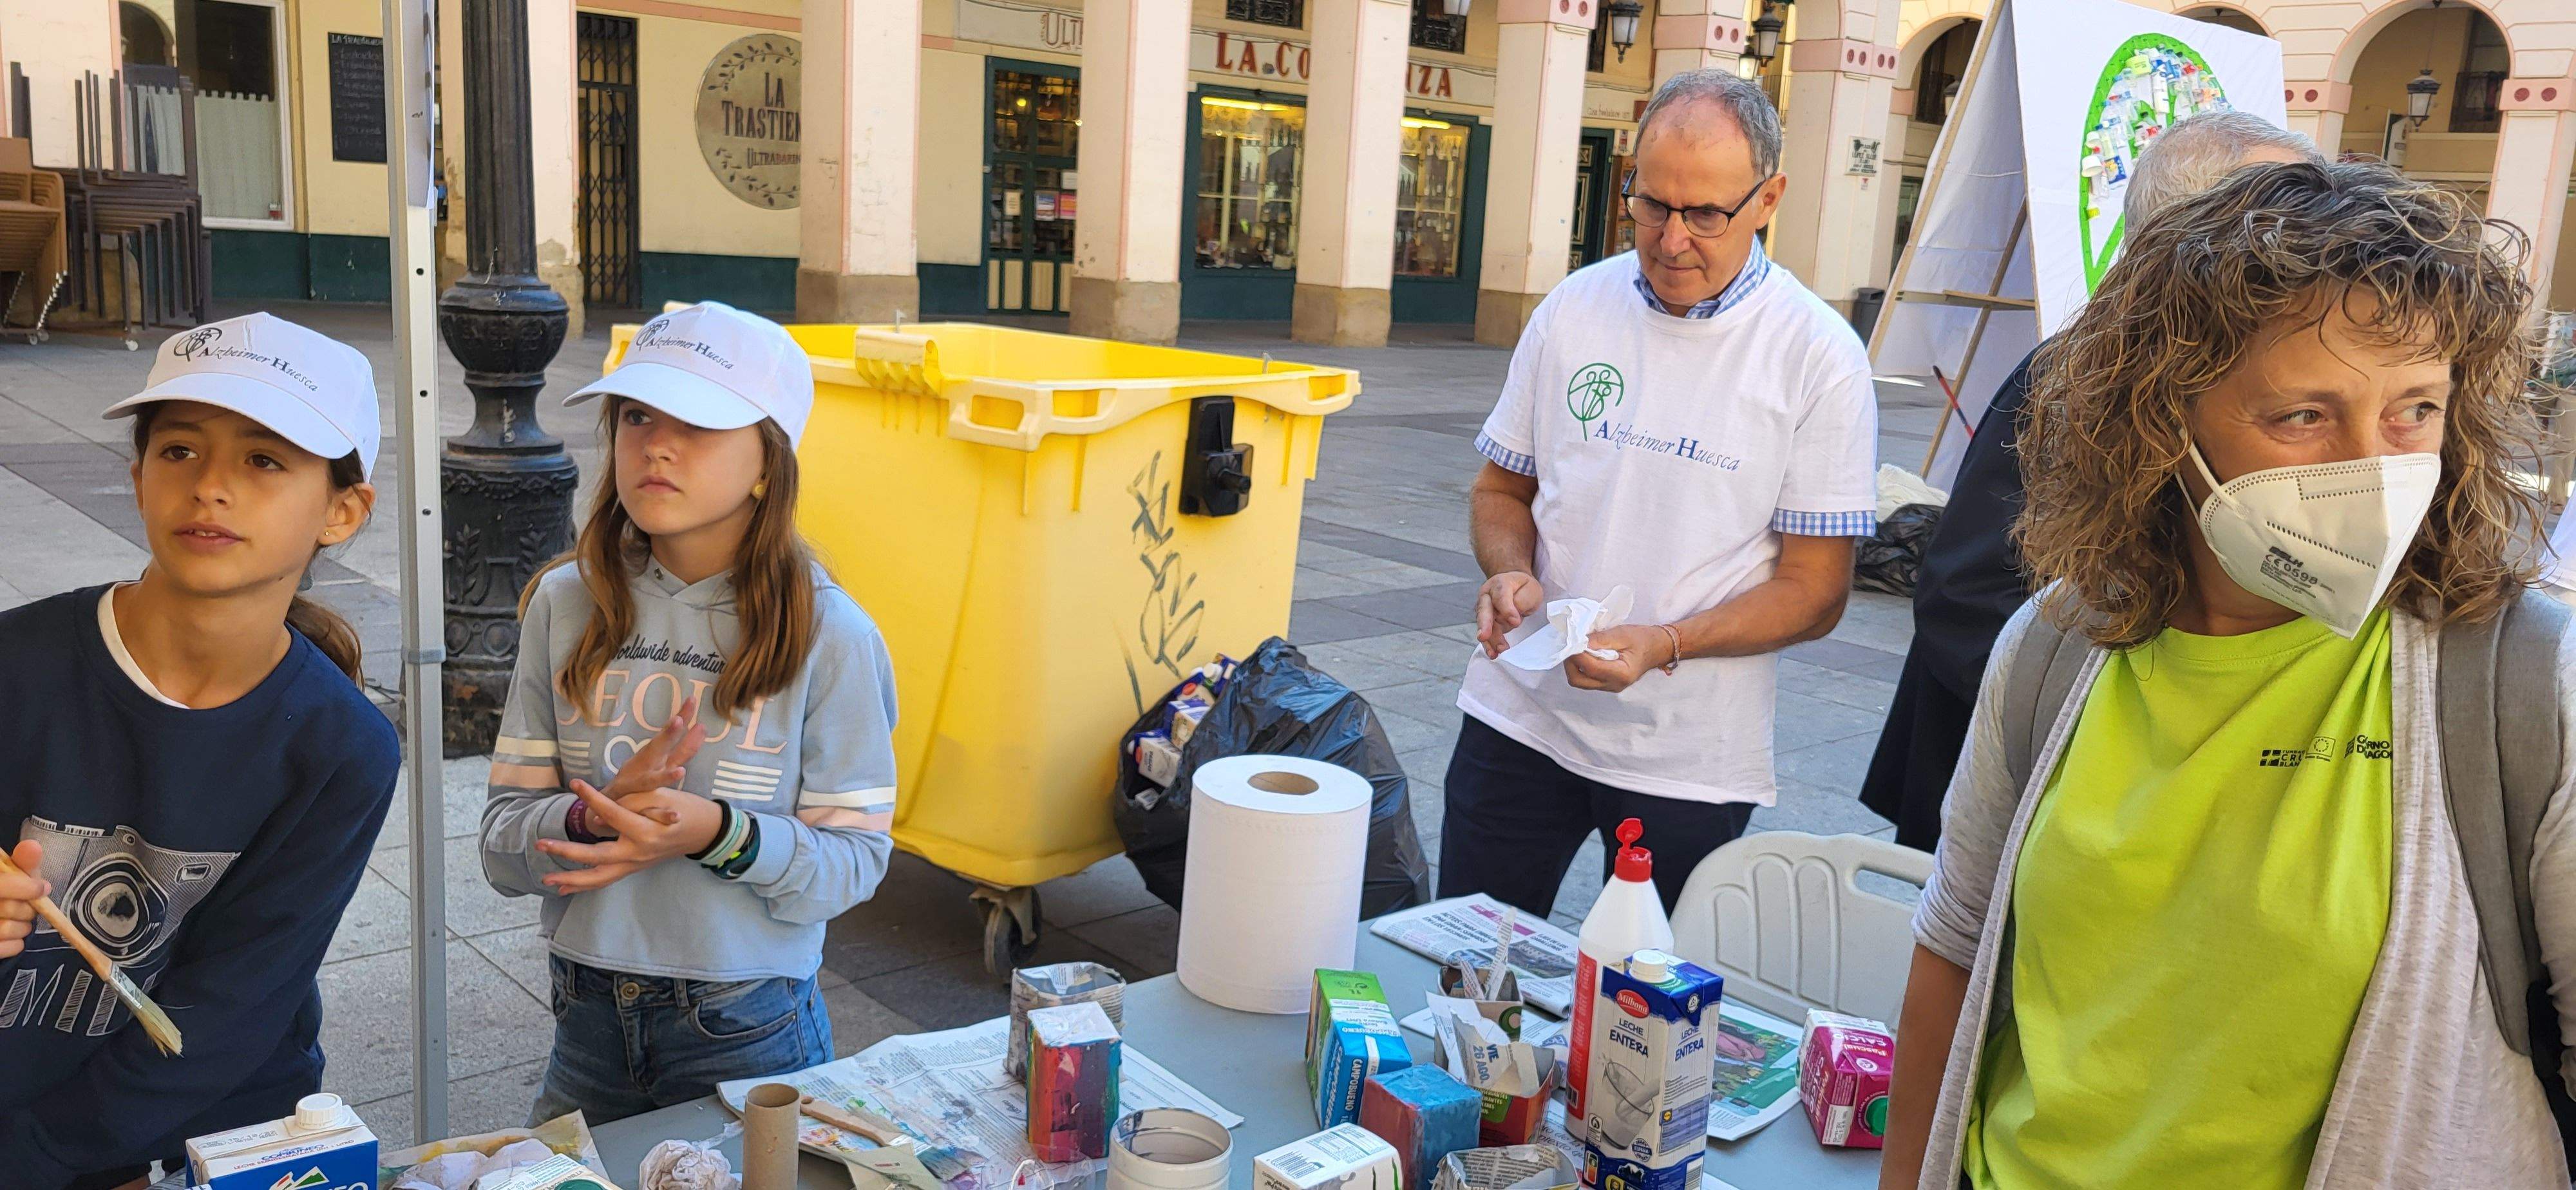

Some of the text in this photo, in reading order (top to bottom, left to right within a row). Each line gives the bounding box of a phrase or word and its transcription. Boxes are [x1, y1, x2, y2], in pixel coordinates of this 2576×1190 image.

[1217, 32, 1256, 73] LA
[764, 72, 785, 108] LA
[645, 336, 735, 370] Alzheimer Huesca
[197, 346, 319, 392] Alzheimer Huesca
[1593, 419, 1740, 471] Alzheimer Huesca
[2284, 563, 2318, 585] 0598
[1618, 992, 1647, 1014] Milbona
[1619, 1018, 1643, 1036] LECHE
[1681, 1025, 1699, 1040] LECHE
[1833, 1033, 1887, 1046] CALCIO
[1473, 1045, 1484, 1060] 26
[1609, 1029, 1649, 1058] ENTERA
[1675, 1037, 1703, 1062] ENTERA
[1844, 1043, 1888, 1057] Pascual
[1345, 1059, 1363, 1111] CAMPOBUENO
